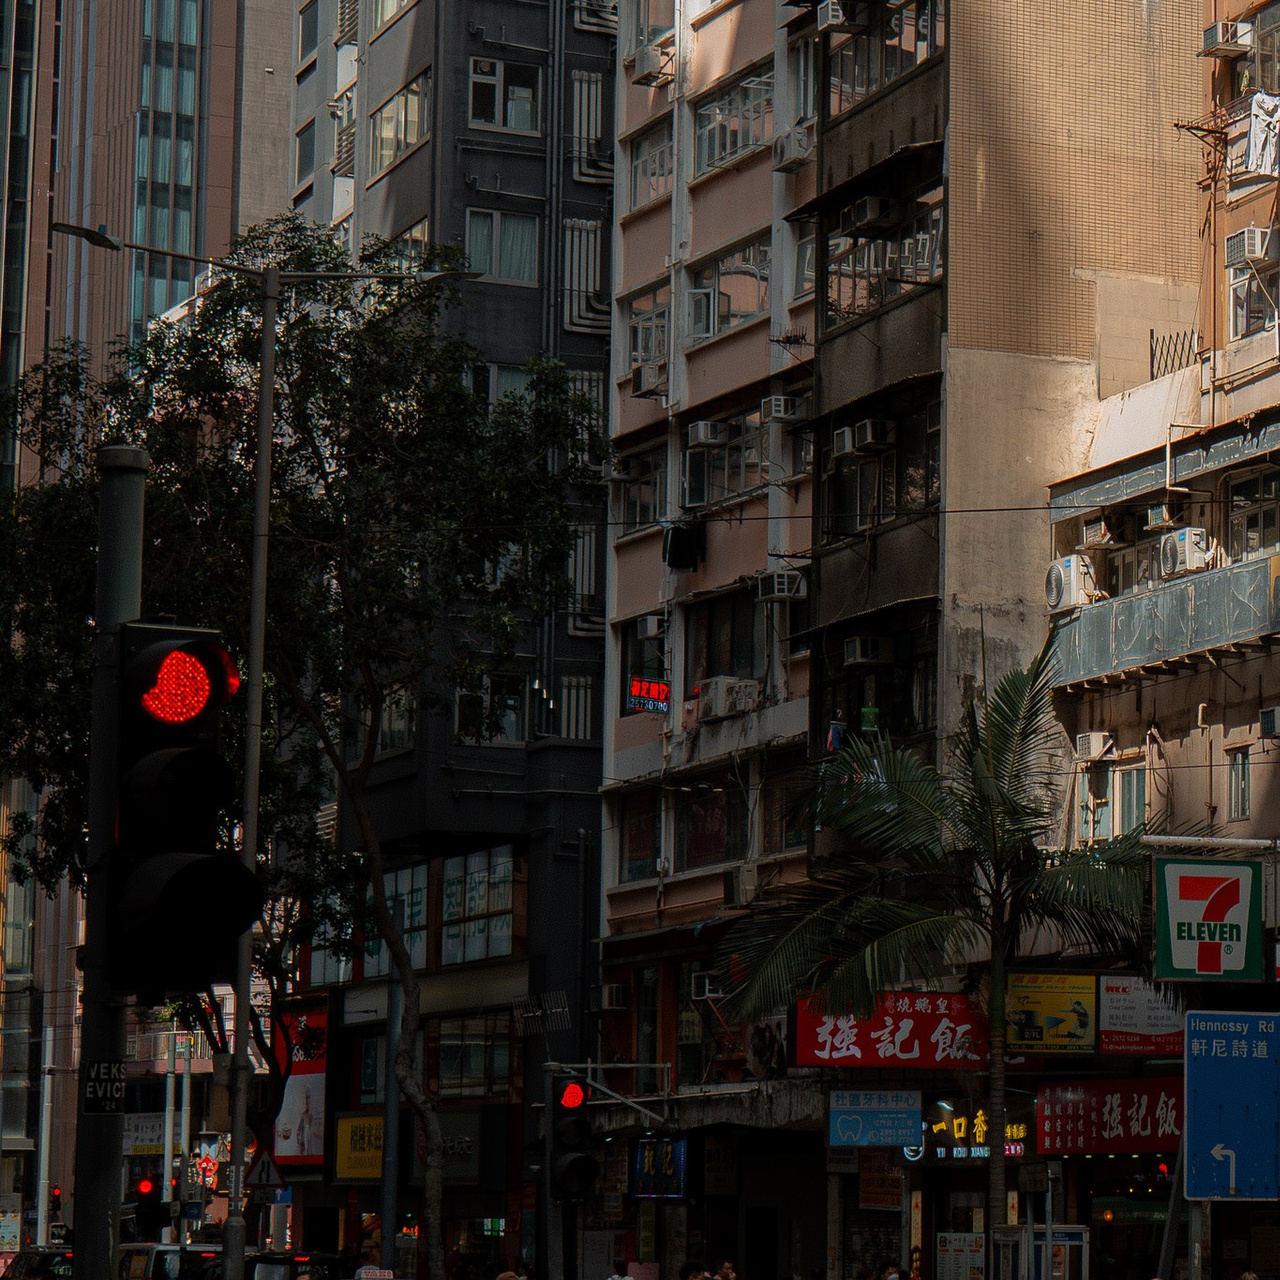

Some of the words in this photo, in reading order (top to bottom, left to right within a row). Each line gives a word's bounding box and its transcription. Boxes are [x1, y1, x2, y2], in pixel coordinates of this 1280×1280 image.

[1191, 1020, 1249, 1035] Hennessy
[1258, 1021, 1275, 1033] Rd
[814, 1014, 1025, 1064] 強記飯
[1191, 1038, 1269, 1058] 軒尼詩道
[932, 1109, 989, 1143] 一口香
[363, 1270, 392, 1278] TAXI
